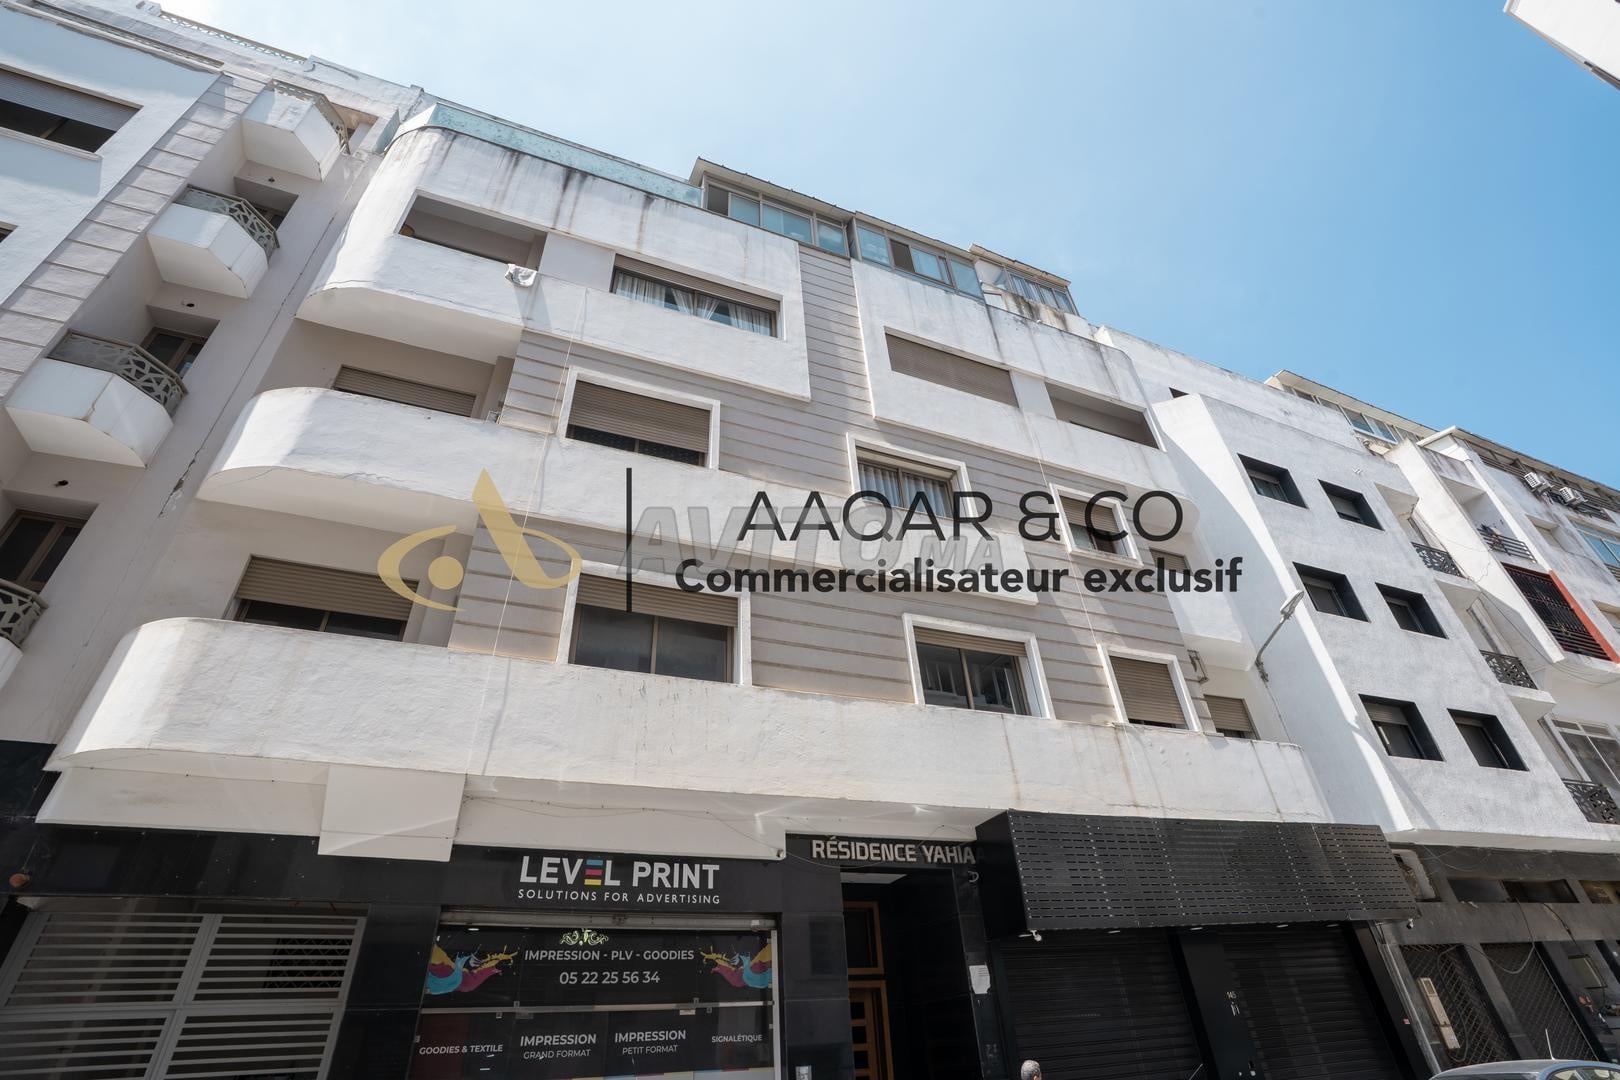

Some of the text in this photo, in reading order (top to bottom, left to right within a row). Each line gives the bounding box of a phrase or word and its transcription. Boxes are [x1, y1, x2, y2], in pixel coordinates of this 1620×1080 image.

[812, 836, 976, 864] RÉSIDENCE YAHIA
[520, 856, 720, 889] LEVEL PRINT
[518, 888, 720, 904] SOLUTIONS FOR ADVERTISING
[524, 950, 600, 961] IMPRESSION
[611, 950, 633, 960] PLV
[643, 950, 695, 960] GOODIES
[559, 971, 661, 984] 05 22 25 56 34
[520, 1033, 597, 1047] IMPRESSION
[614, 1029, 687, 1043] IMPRESSION
[711, 1033, 763, 1043] SIGNALÉTIQUE
[419, 1044, 503, 1055] GOODIES & TEXTILE
[523, 1049, 591, 1060] GRAND FORMAT
[622, 1044, 678, 1055] PETIT FORMAT
